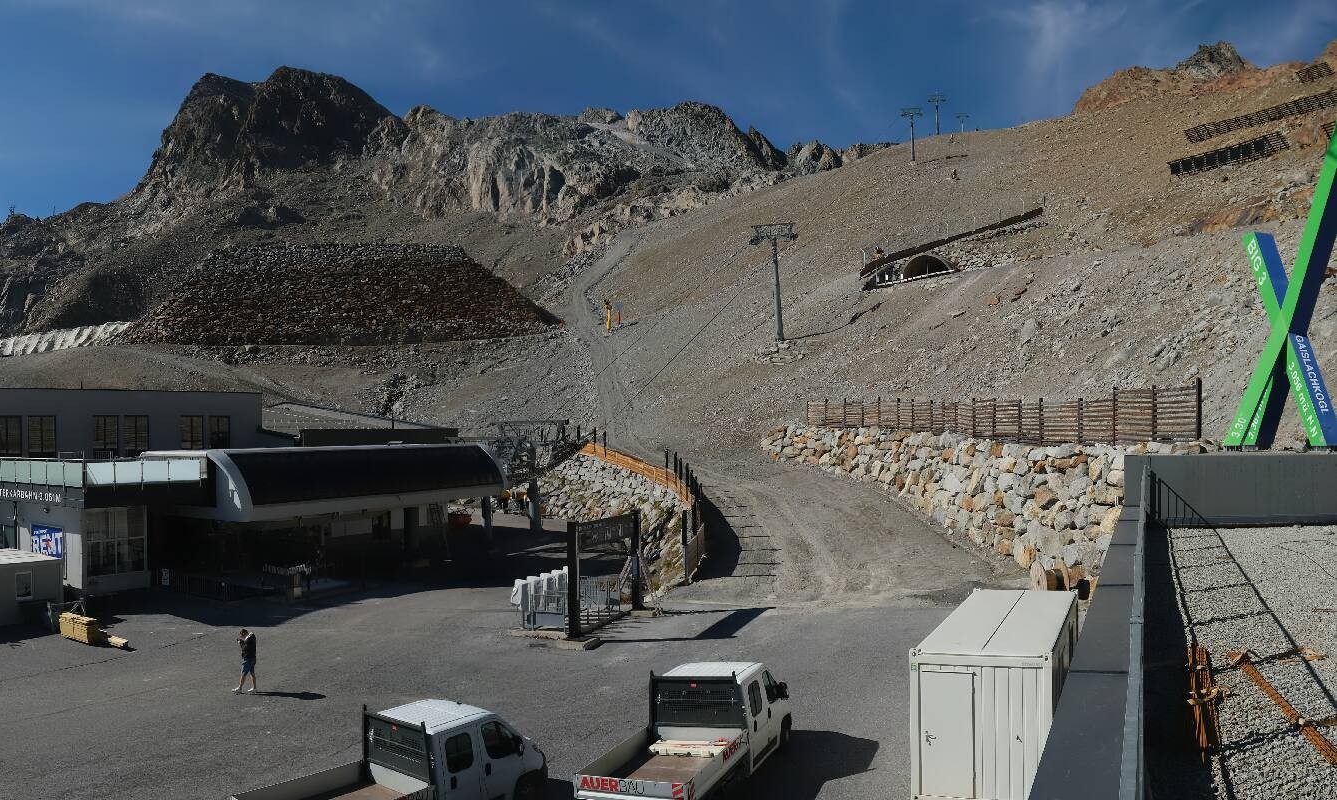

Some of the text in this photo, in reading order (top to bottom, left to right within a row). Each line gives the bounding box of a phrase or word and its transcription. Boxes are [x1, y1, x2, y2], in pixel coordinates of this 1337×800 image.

[1247, 238, 1267, 286] BIG 3
[1295, 335, 1329, 415] GAISLACHKOGL
